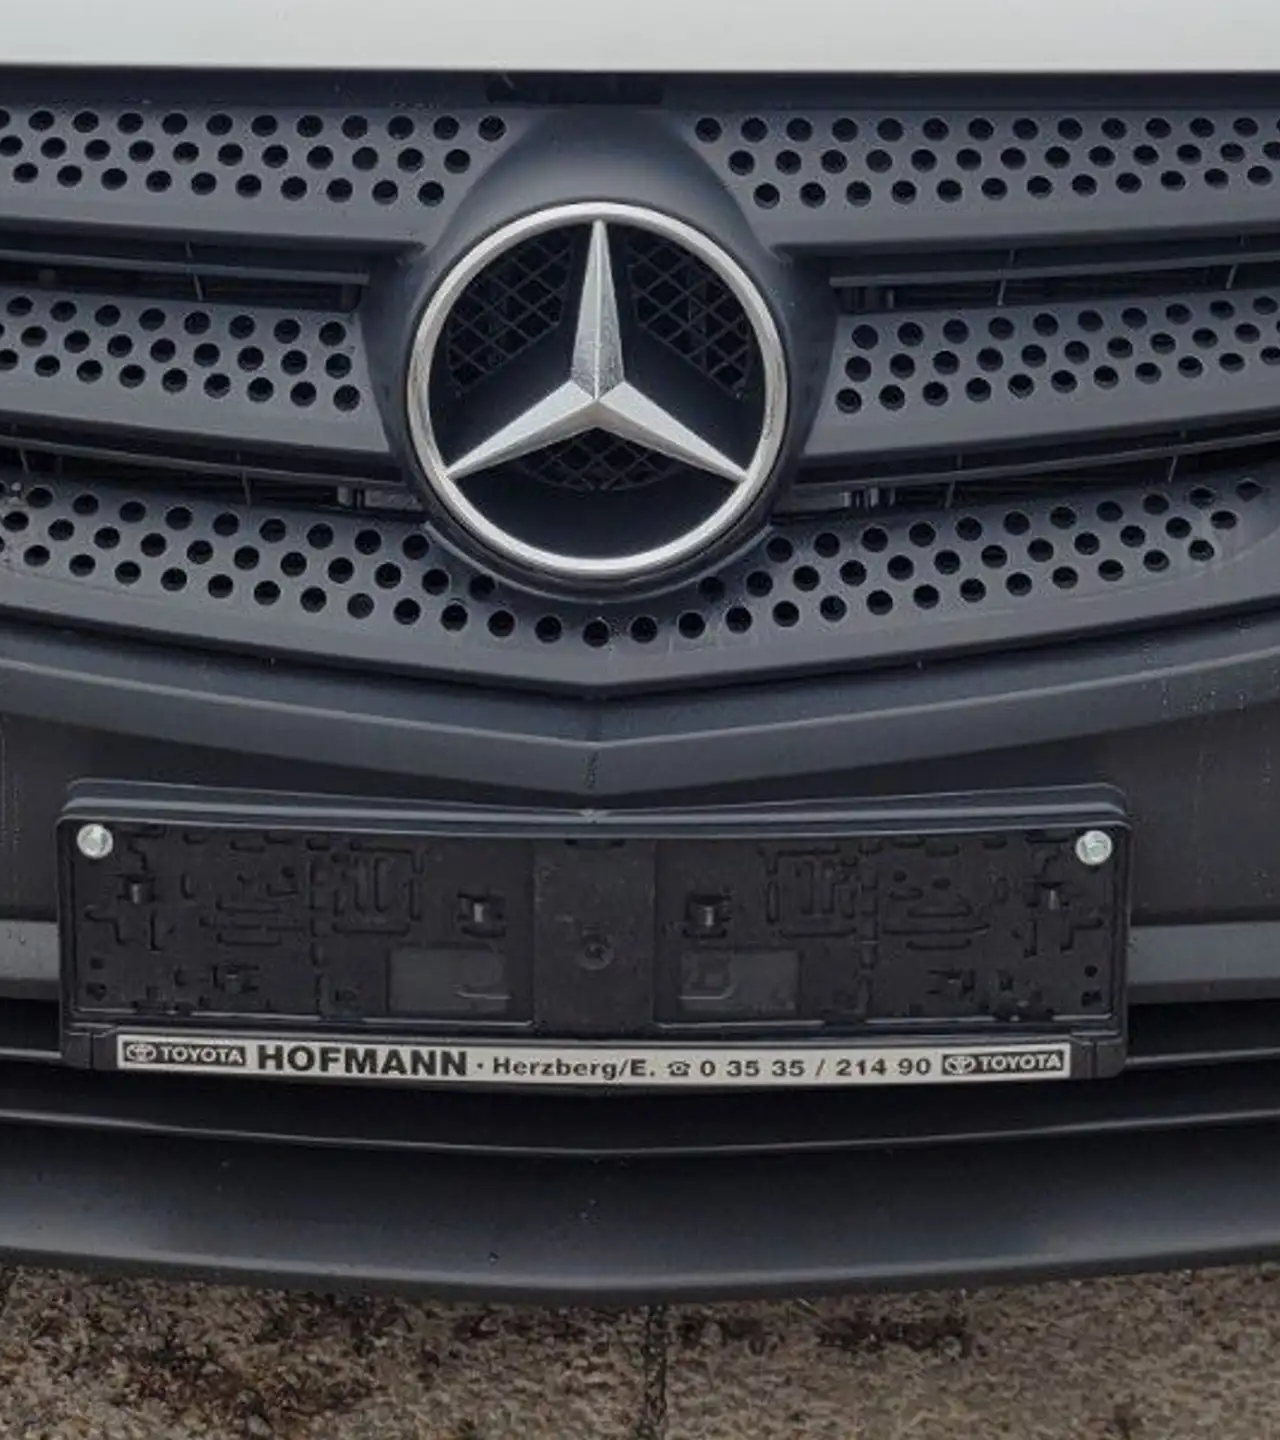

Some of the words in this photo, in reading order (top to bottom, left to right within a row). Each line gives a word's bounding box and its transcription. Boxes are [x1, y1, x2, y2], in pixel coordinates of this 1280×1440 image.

[160, 1044, 244, 1065] TOYOTA
[257, 1045, 468, 1076] HOFMANN
[700, 1060, 715, 1076] 0
[726, 1060, 759, 1077] 35
[771, 1060, 805, 1077] 35
[835, 1059, 887, 1077] 214
[898, 1058, 931, 1076] 90
[978, 1052, 1064, 1072] TOYOTA
